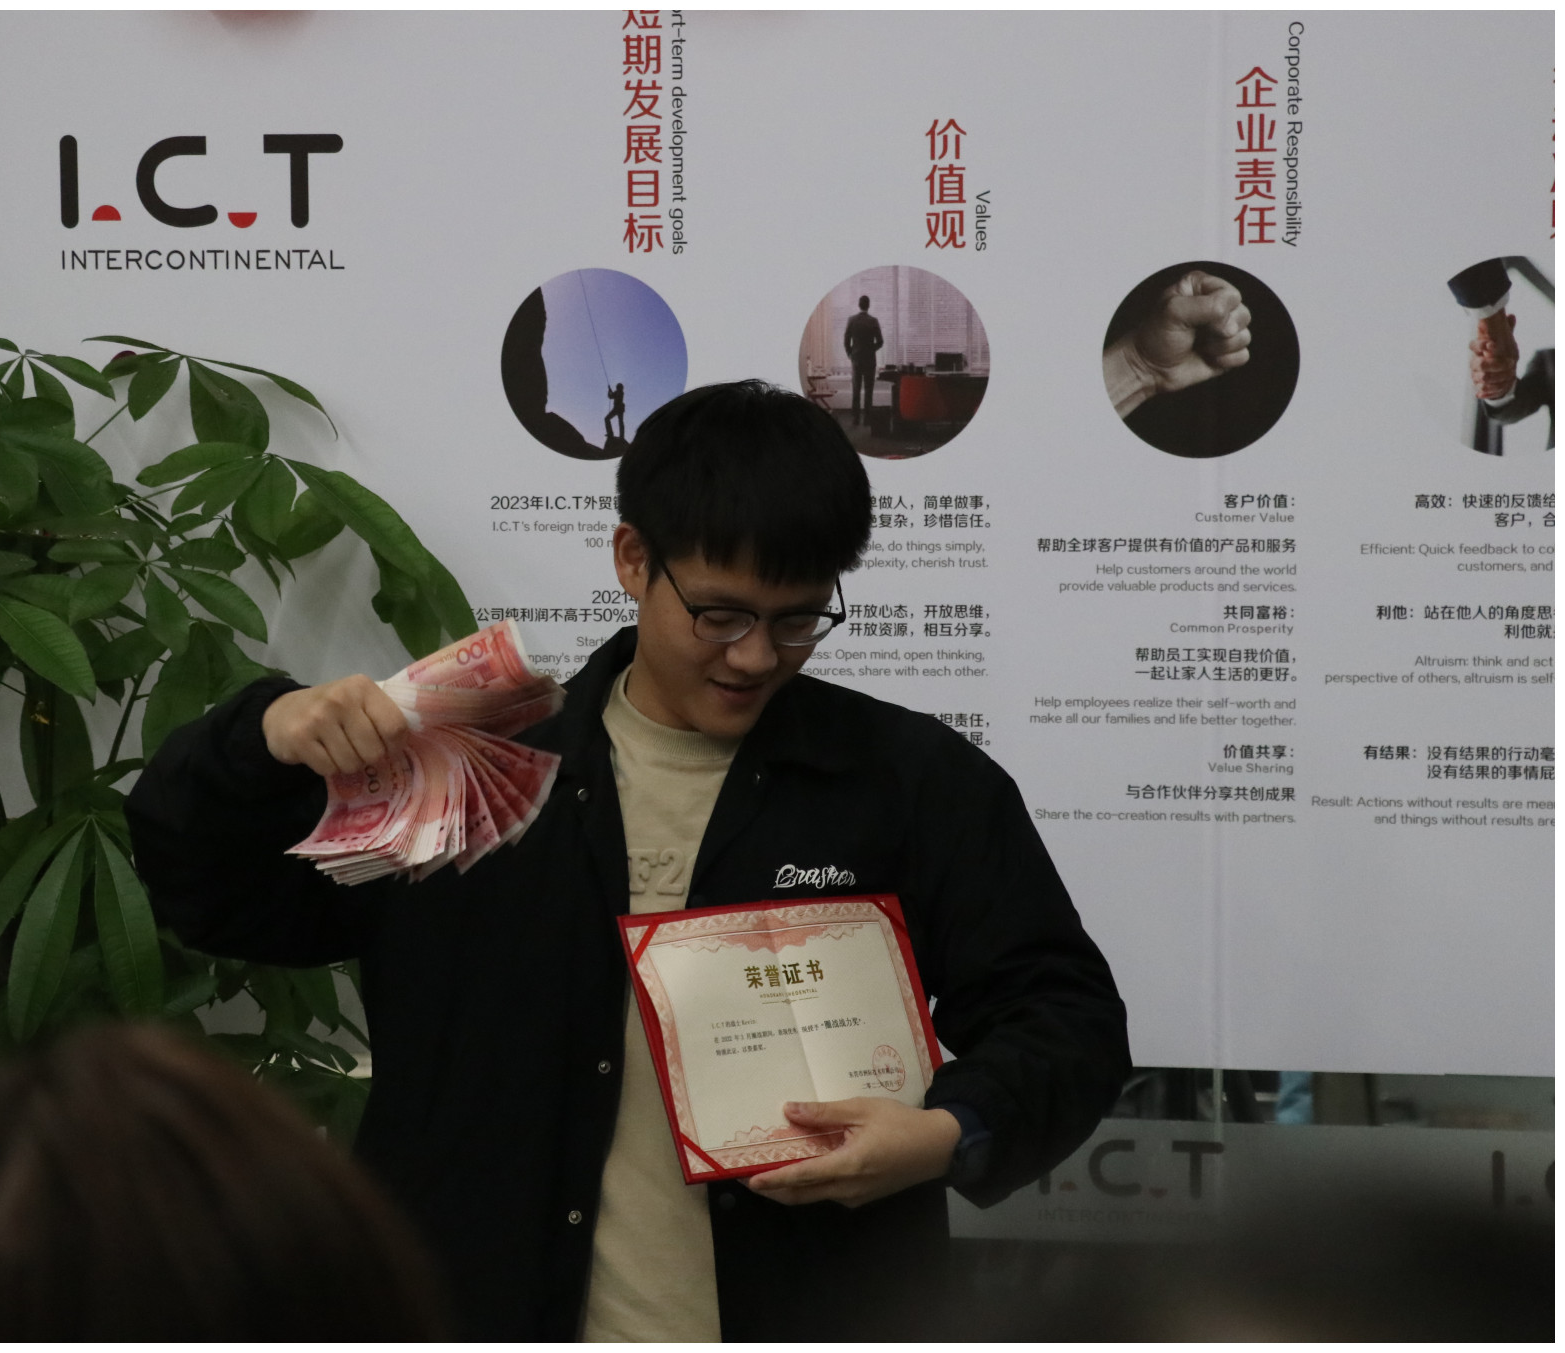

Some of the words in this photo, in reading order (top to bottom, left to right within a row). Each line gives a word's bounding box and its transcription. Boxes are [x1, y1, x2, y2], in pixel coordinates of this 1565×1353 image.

[1284, 21, 1305, 116] Corporate
[668, 85, 688, 204] development
[1233, 66, 1279, 247] 企业责任
[58, 133, 345, 229] I.C.T
[925, 118, 968, 250] 价值观
[1282, 121, 1303, 247] Responsibility
[975, 190, 992, 252] Values
[668, 208, 688, 255] goals
[60, 248, 346, 271] INTERCONTINENTAL
[1224, 494, 1295, 509] 客户价值：
[1195, 512, 1256, 523] Customer
[1259, 512, 1295, 523] Value
[1037, 538, 1297, 553] 帮助全球客户提供有价值的产品和服务
[1360, 544, 1416, 555] Efficient:
[1418, 544, 1455, 557] Quick
[1459, 544, 1517, 555] feedback
[1522, 544, 1535, 555] to
[1096, 563, 1123, 577] Help
[1126, 564, 1191, 575] customers
[1194, 564, 1237, 575] around
[1240, 564, 1260, 575] the
[1263, 564, 1297, 575] world
[1457, 561, 1527, 573] customers,
[1530, 561, 1554, 572] and
[1059, 580, 1104, 594] provide
[1107, 580, 1156, 592] valuable
[1160, 580, 1214, 594] products
[1217, 580, 1240, 592] and
[1243, 582, 1297, 593] services.
[1223, 605, 1295, 620] 共同富裕：
[848, 622, 992, 638] 开放资源，相互分享。
[1170, 622, 1225, 633] Common
[1227, 622, 1294, 636] Prosperity
[1135, 647, 1297, 664] 帮助员工实现自我价值，
[1414, 656, 1469, 667] Altruism:
[1472, 656, 1503, 667] think
[1506, 656, 1530, 667] and
[1533, 656, 1553, 667] act
[1135, 666, 1298, 682] 一起让家人生活的更好。
[1325, 673, 1399, 686] perspective
[1402, 673, 1416, 685] of
[1418, 673, 1461, 686] others,
[1463, 673, 1514, 685] altruism
[1517, 673, 1528, 685] is
[1034, 697, 1061, 710] Help
[1065, 697, 1130, 711] employees
[1133, 697, 1173, 709] realize
[1176, 697, 1204, 709] their
[1207, 697, 1270, 709] self-worth
[1274, 697, 1297, 709] and
[1030, 713, 1062, 725] make
[1065, 713, 1078, 725] all
[1082, 715, 1100, 725] our
[1105, 713, 1151, 725] families
[1154, 713, 1176, 725] and
[1179, 713, 1198, 725] life
[1201, 713, 1237, 725] better
[1241, 714, 1297, 728] together.
[1223, 744, 1295, 759] 价值共享：
[1208, 762, 1243, 773] Value
[1245, 762, 1294, 775] Sharing
[1125, 784, 1296, 802] 与合作伙伴分享共创成果
[1311, 795, 1354, 808] Result:
[1356, 796, 1403, 808] Actions
[1407, 796, 1452, 808] without
[1456, 797, 1499, 809] results
[1502, 799, 1523, 809] are
[1034, 809, 1070, 820] Share
[1073, 809, 1093, 820] the
[1096, 809, 1167, 820] co-creation
[1170, 809, 1211, 820] results
[1214, 810, 1240, 821] with
[1243, 811, 1297, 824] partners.
[1374, 814, 1397, 826] and
[1400, 814, 1438, 828] things
[1441, 814, 1487, 826] without
[1491, 814, 1534, 826] results
[744, 959, 825, 990] 荣誉证书
